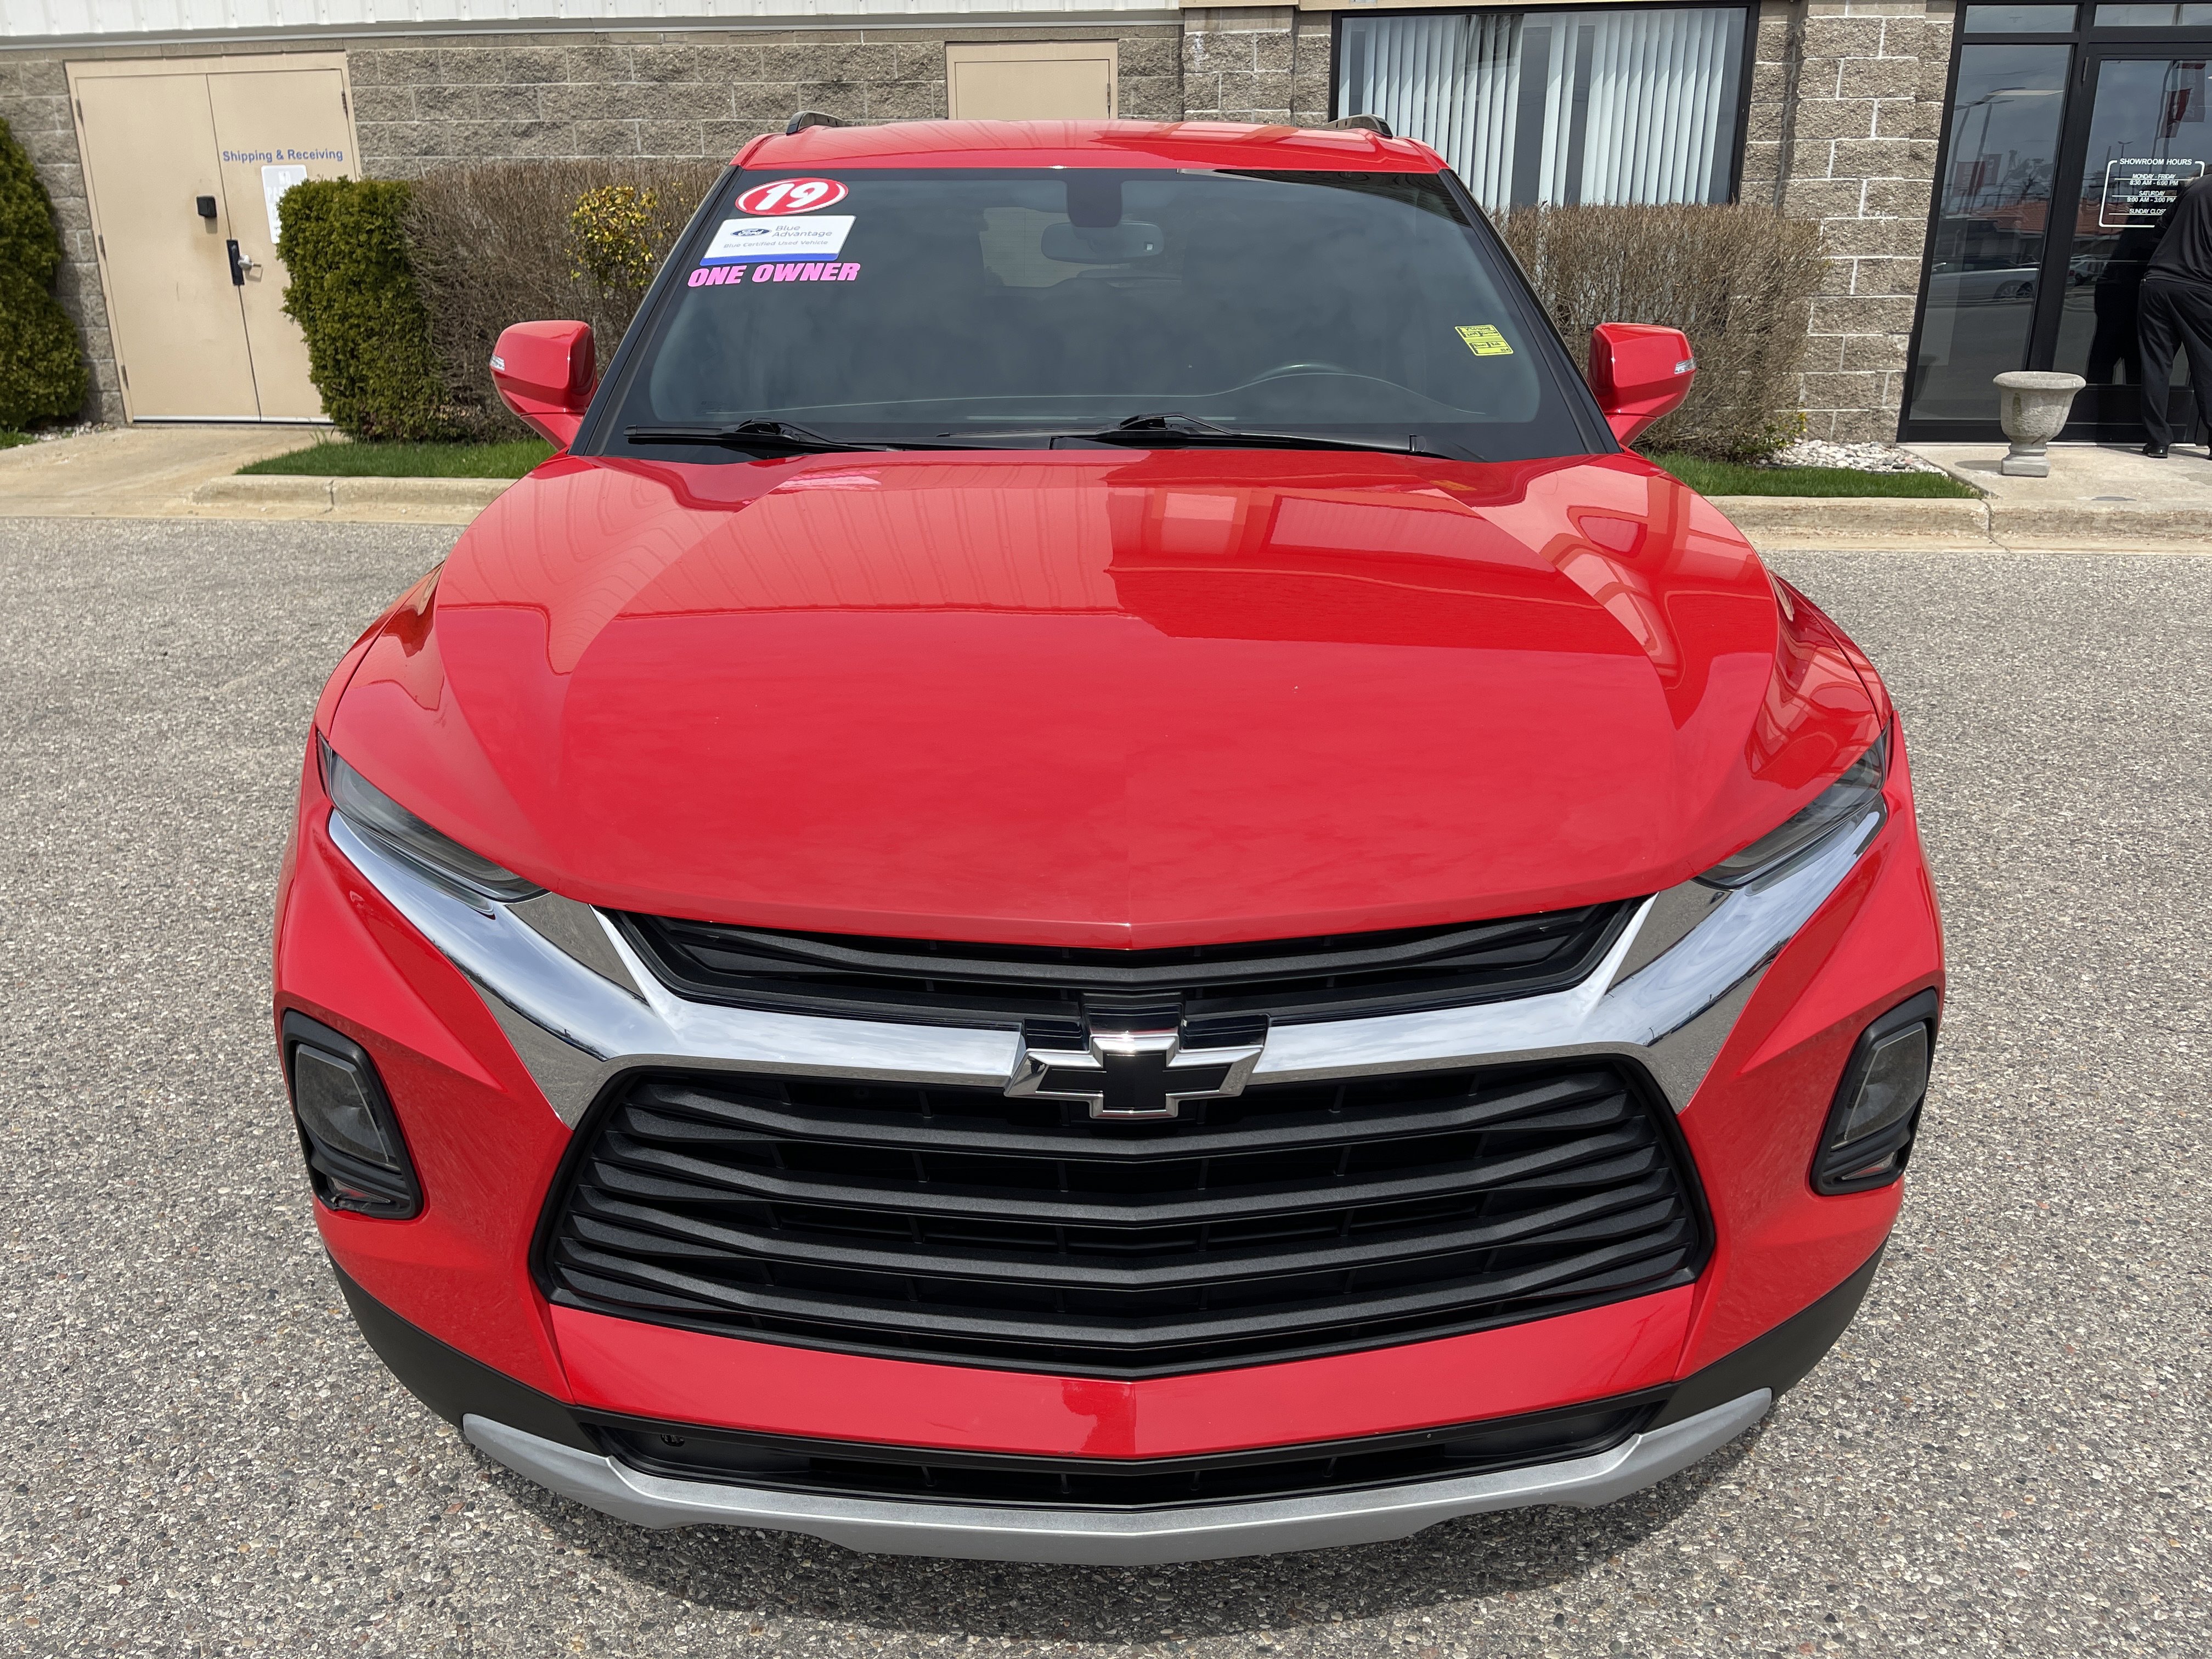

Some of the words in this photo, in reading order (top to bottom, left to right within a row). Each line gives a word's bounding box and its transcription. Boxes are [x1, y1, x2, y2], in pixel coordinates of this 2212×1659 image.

[223, 150, 273, 163] Shipping
[276, 149, 284, 160] &
[288, 148, 343, 162] Receiving
[755, 182, 828, 211] 19
[687, 265, 747, 287] ONE
[752, 263, 860, 283] OWNER
